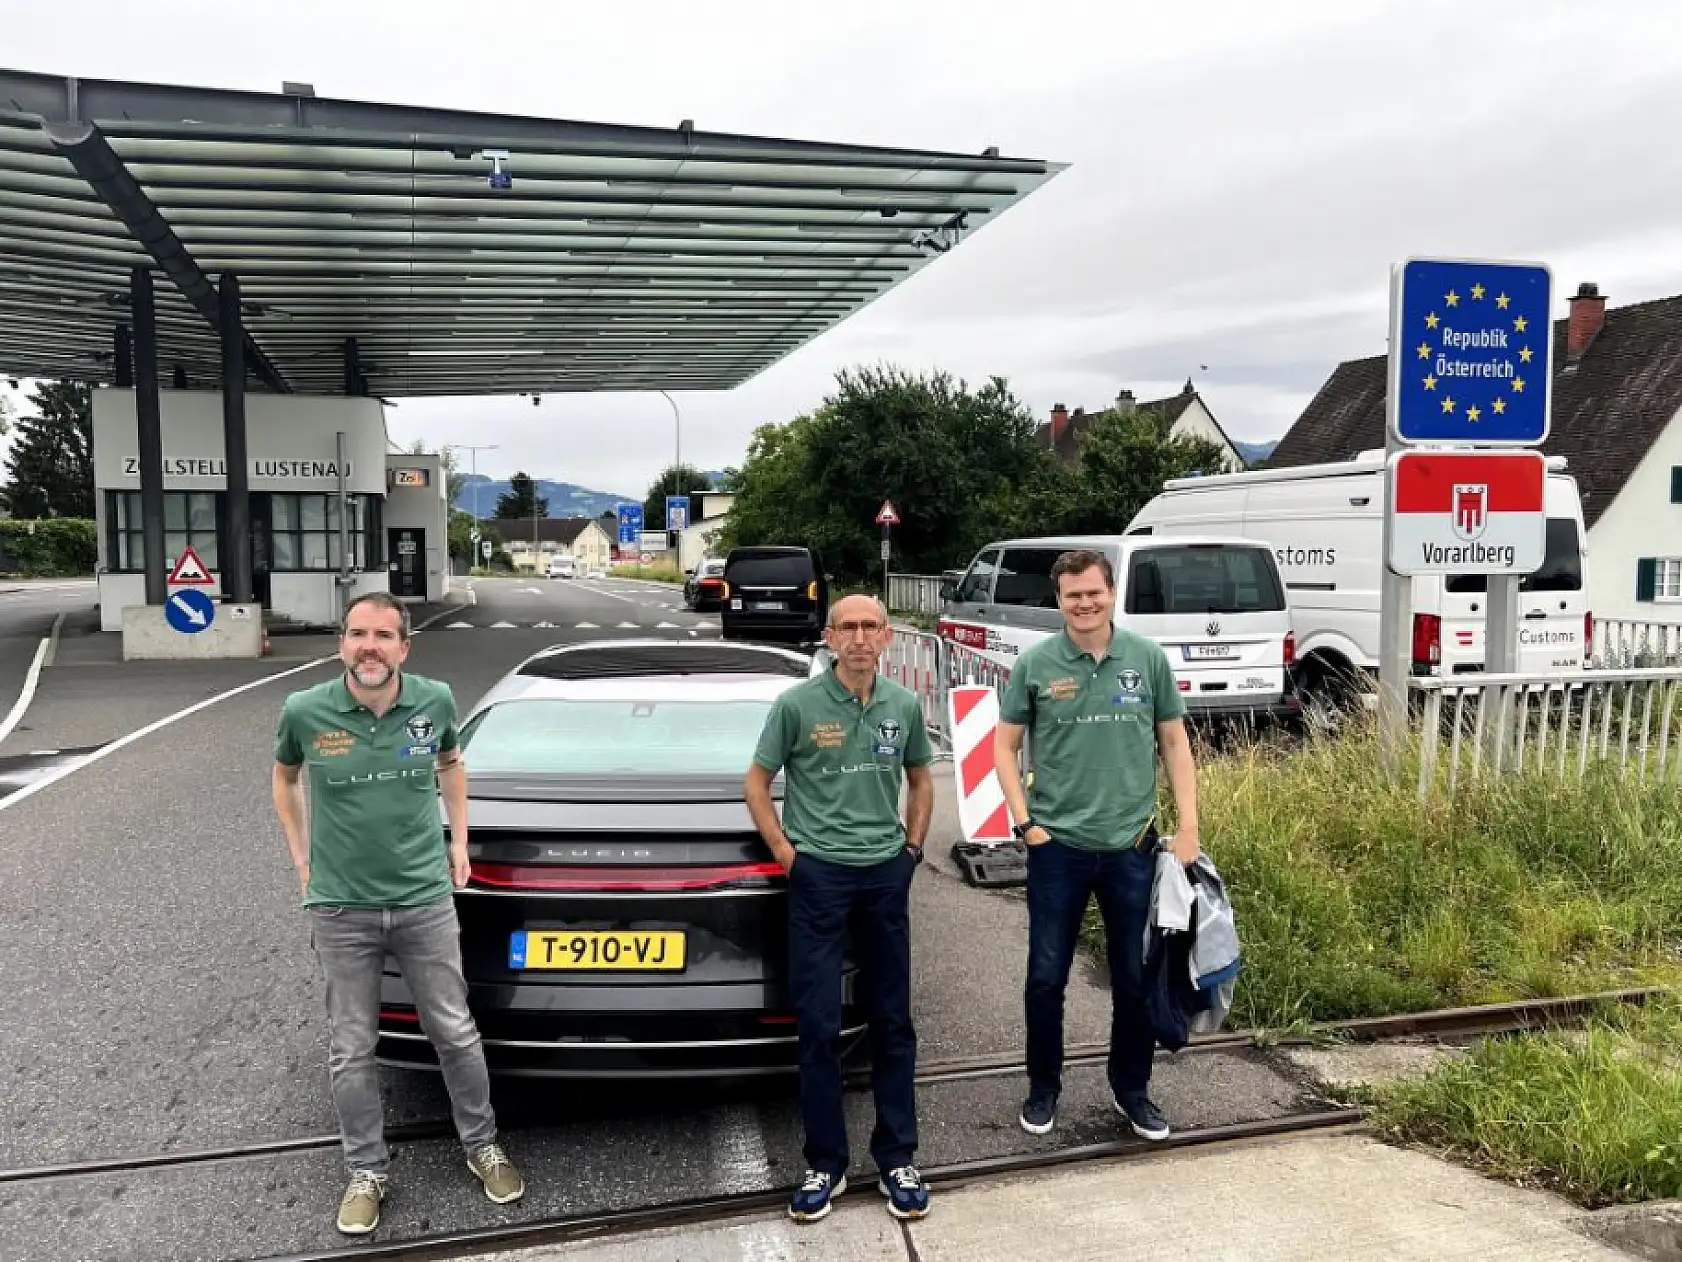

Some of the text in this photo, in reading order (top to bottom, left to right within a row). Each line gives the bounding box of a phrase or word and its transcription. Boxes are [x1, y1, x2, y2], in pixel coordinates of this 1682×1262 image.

[1443, 327, 1507, 350] Republik
[1436, 353, 1514, 378] Österreich
[124, 458, 230, 475] ZLSTELL
[1422, 543, 1515, 567] Vorarlberg
[822, 762, 892, 774] LUCD
[547, 849, 651, 857] LUCID
[541, 936, 667, 964] T-910-VJ
